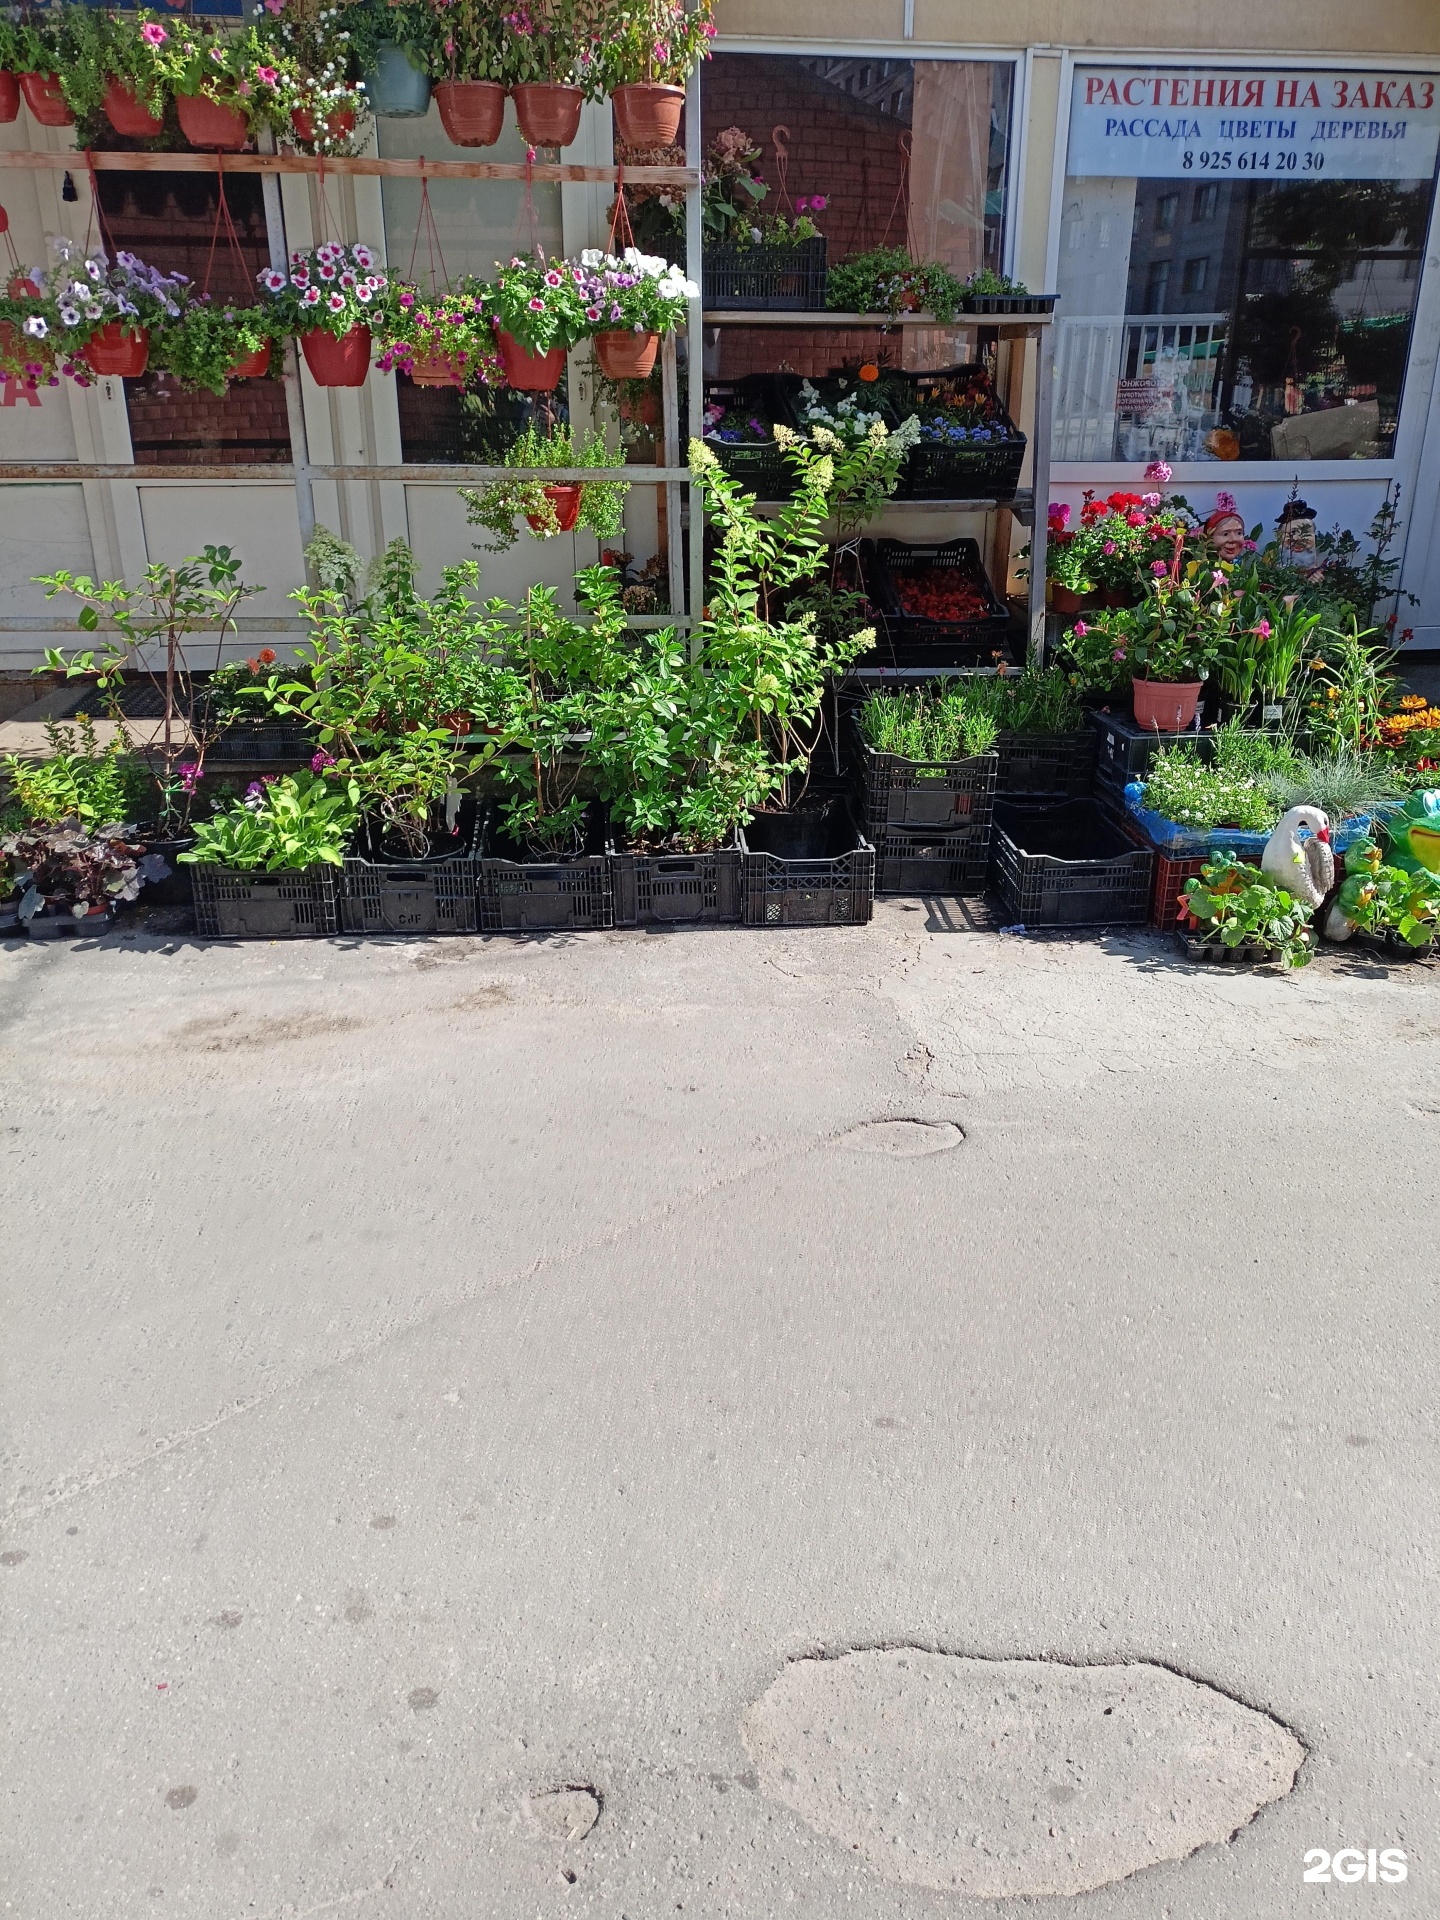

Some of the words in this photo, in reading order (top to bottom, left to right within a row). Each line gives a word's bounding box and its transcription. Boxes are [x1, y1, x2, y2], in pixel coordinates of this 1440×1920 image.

[1084, 77, 1267, 107] РАСТЕНИЯ
[1274, 79, 1321, 108] НА
[1331, 80, 1435, 109] ЗАКАЗ
[1104, 118, 1202, 141] РАССАДА
[1219, 120, 1297, 142] ЦВЕТЫ
[1310, 121, 1407, 143] ДЕРЕВЬЯ
[1182, 151, 1194, 170] 8
[1199, 151, 1232, 170] 925
[1237, 151, 1269, 170] 614
[1275, 151, 1297, 170] 20
[1302, 151, 1325, 171] 30
